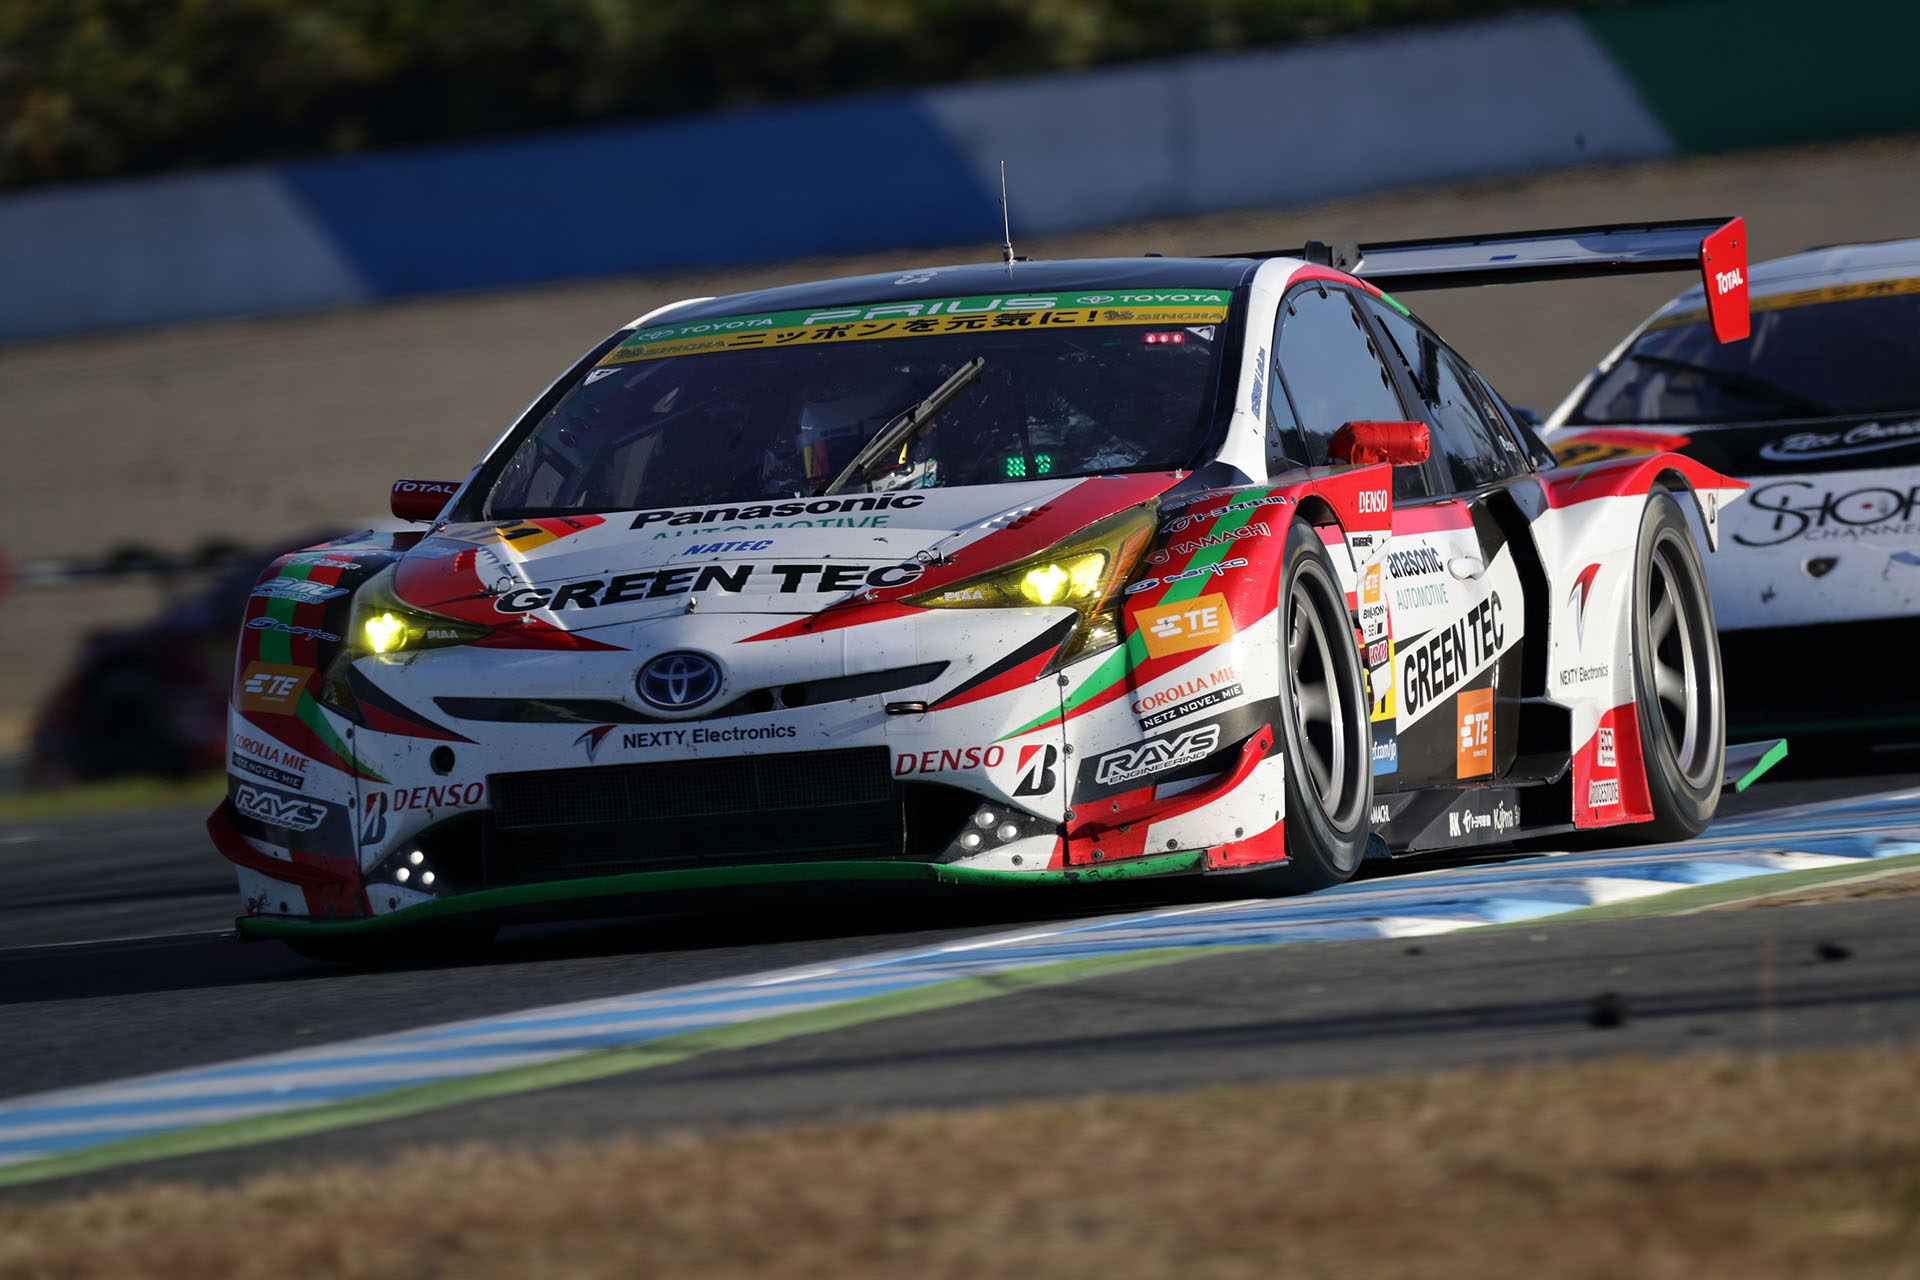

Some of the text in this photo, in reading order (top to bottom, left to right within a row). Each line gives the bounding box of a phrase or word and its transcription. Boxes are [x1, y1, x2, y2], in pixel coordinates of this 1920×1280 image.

[1716, 267, 1744, 296] TOTAL
[803, 296, 1058, 326] PRIUS
[1119, 294, 1223, 303] TOYOTA
[680, 317, 774, 336] TOYOTA
[728, 310, 1098, 347] ニッポンを元気に!
[1135, 312, 1223, 320] SINGHA
[394, 480, 456, 496] TOTAL
[1358, 489, 1388, 514] DENSO
[629, 492, 926, 530] Panasonic
[681, 539, 775, 556] NATEC
[1170, 522, 1272, 555] TAMACHI
[1163, 557, 1249, 584] sanko
[497, 562, 923, 613] GREEN TEC
[943, 589, 984, 602] PIAA
[1397, 582, 1449, 611] AUTOMOTIVE
[1184, 606, 1219, 631] TE
[426, 628, 460, 640] PIAA
[1403, 617, 1468, 716] GREEN
[1467, 590, 1504, 668] TEC
[268, 675, 300, 696] TE
[1559, 661, 1609, 688] NEXTY Electronics
[1131, 665, 1241, 715] COROLLA MIE
[1144, 685, 1242, 728] NETZ NOVEL MIE
[623, 722, 797, 749] NEXTY Electronics
[1475, 711, 1490, 746] TE
[233, 733, 310, 773] COROLLA MIE
[895, 745, 1005, 777] DENSO
[1099, 725, 1219, 780] RAYS
[1108, 749, 1208, 784] ENGINEERING
[248, 763, 280, 779] NOVEL
[235, 785, 328, 828] RAYS
[393, 782, 484, 812] DENSO
